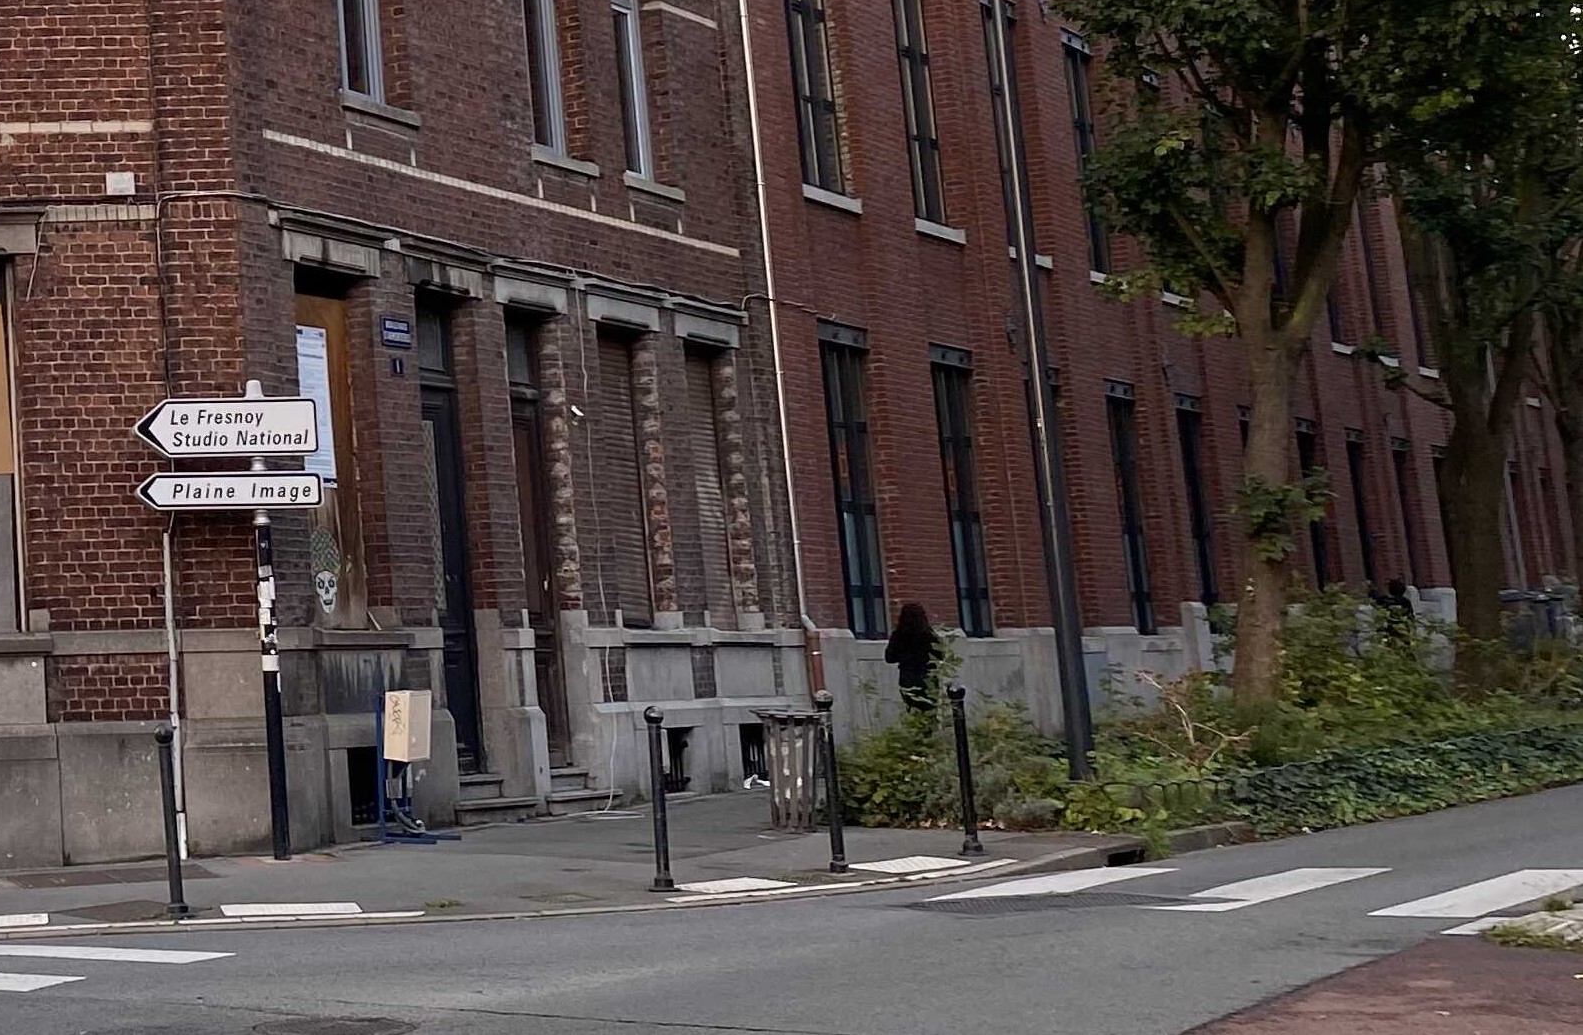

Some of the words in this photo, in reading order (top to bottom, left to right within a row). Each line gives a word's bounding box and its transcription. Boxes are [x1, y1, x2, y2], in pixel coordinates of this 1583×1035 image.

[170, 409, 189, 425] Le
[197, 409, 264, 427] Fresnoy
[172, 430, 229, 447] Studio
[236, 429, 309, 446] National
[172, 483, 236, 499] Plaine
[251, 482, 312, 502] Image
